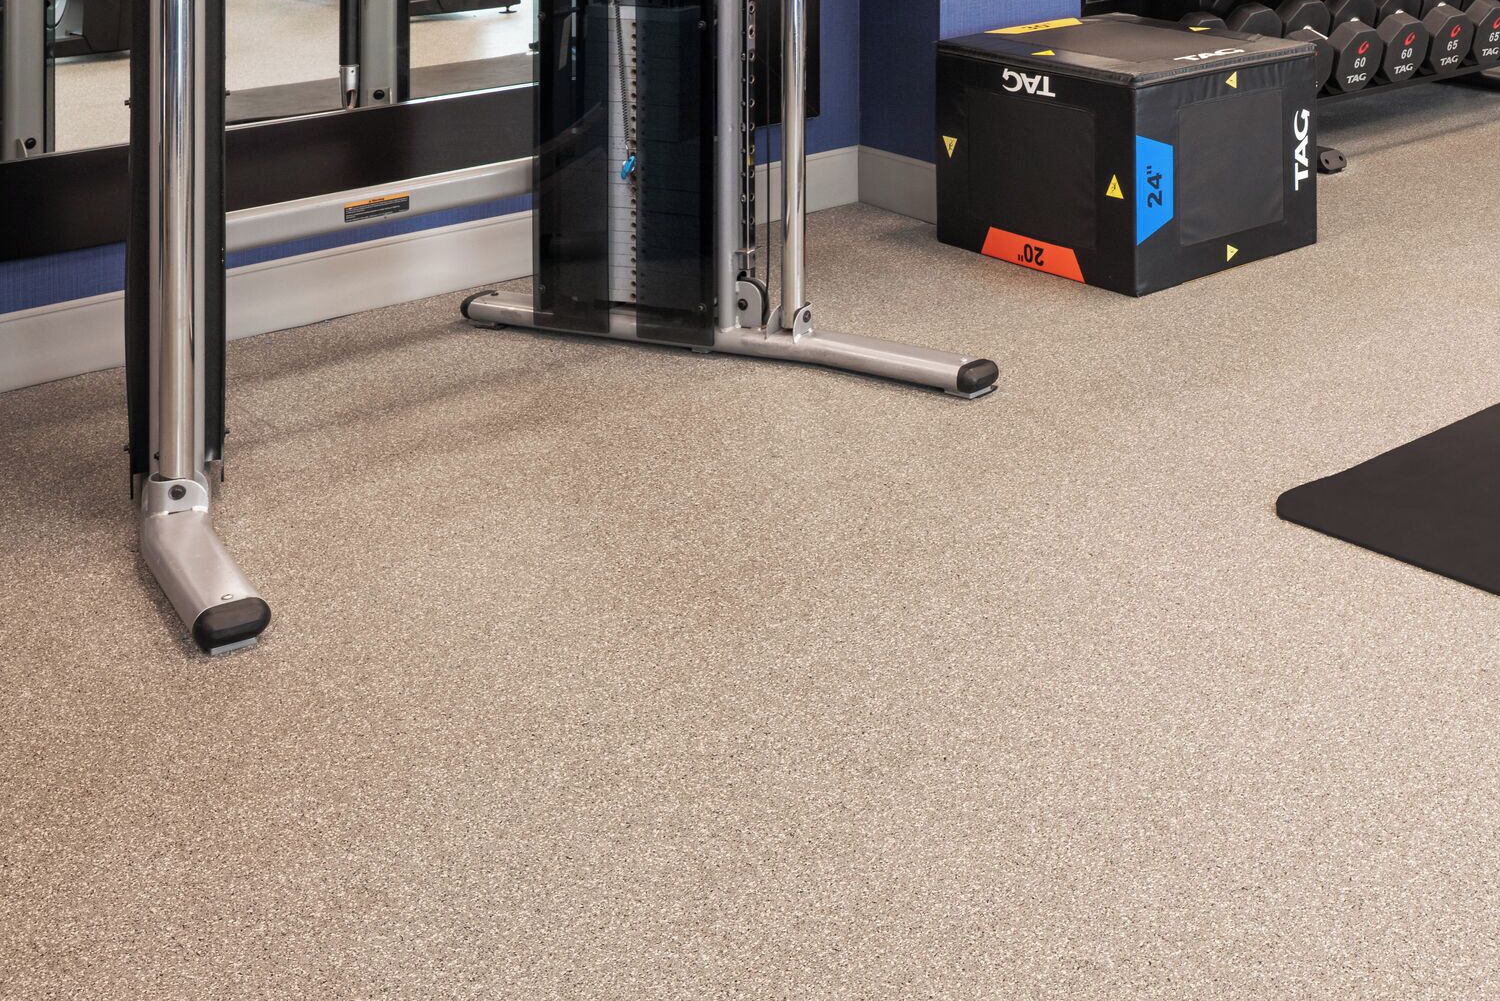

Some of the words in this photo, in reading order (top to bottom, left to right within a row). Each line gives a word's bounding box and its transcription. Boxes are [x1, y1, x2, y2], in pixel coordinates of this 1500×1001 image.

[1488, 31, 1500, 42] 65
[1446, 39, 1459, 51] 65
[1481, 46, 1500, 57] TAG
[1174, 47, 1245, 61] TAG
[1401, 47, 1413, 60] 60
[1353, 56, 1367, 69] 60
[1439, 54, 1460, 67] TAG
[1393, 62, 1414, 75] TAG
[1002, 68, 1056, 98] TAG
[1346, 72, 1367, 84] TAG
[1293, 108, 1311, 191] TAG
[1147, 165, 1163, 208] 24"
[1017, 243, 1045, 267] 20"
